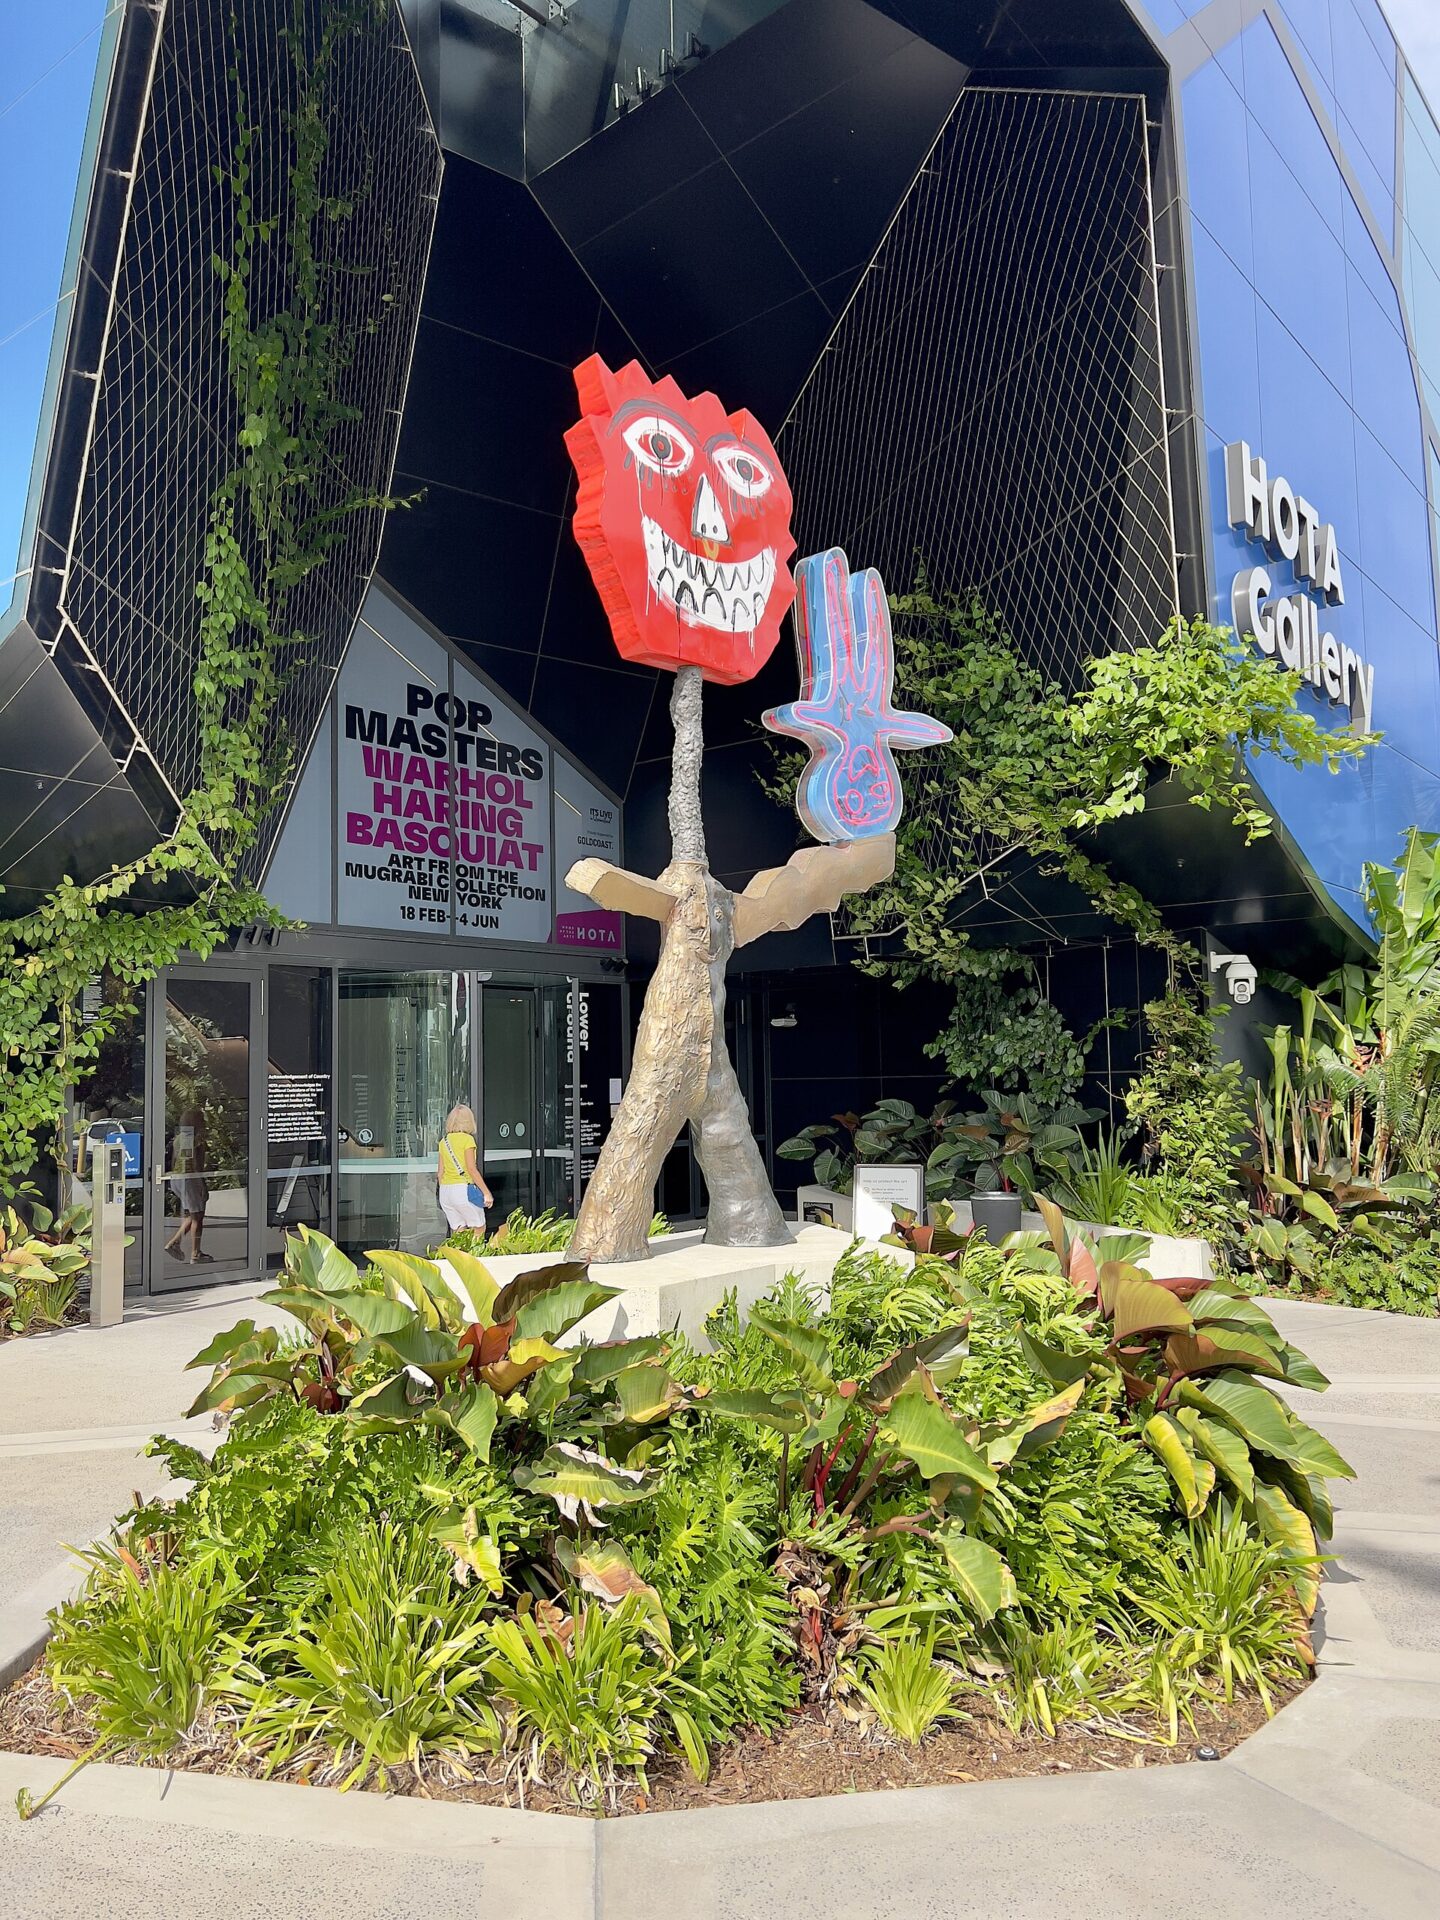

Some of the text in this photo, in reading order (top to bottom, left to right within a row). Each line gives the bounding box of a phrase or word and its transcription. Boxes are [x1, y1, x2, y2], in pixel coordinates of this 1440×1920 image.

[1225, 440, 1345, 606] HOTA
[1232, 567, 1374, 736] Gallery
[406, 683, 493, 733] POP
[345, 704, 544, 781] MASTERS
[362, 745, 533, 809] WARHOL
[373, 782, 523, 838] HARING
[346, 812, 544, 871] BASQUIAT
[387, 853, 518, 885] ART FROM THE
[345, 862, 546, 902] MUGRABI COLLECTION
[408, 885, 502, 911] NEW YORK
[400, 905, 416, 920] 18
[471, 914, 499, 929] JUN
[577, 927, 616, 943] HOTA
[579, 992, 590, 1051] Lower
